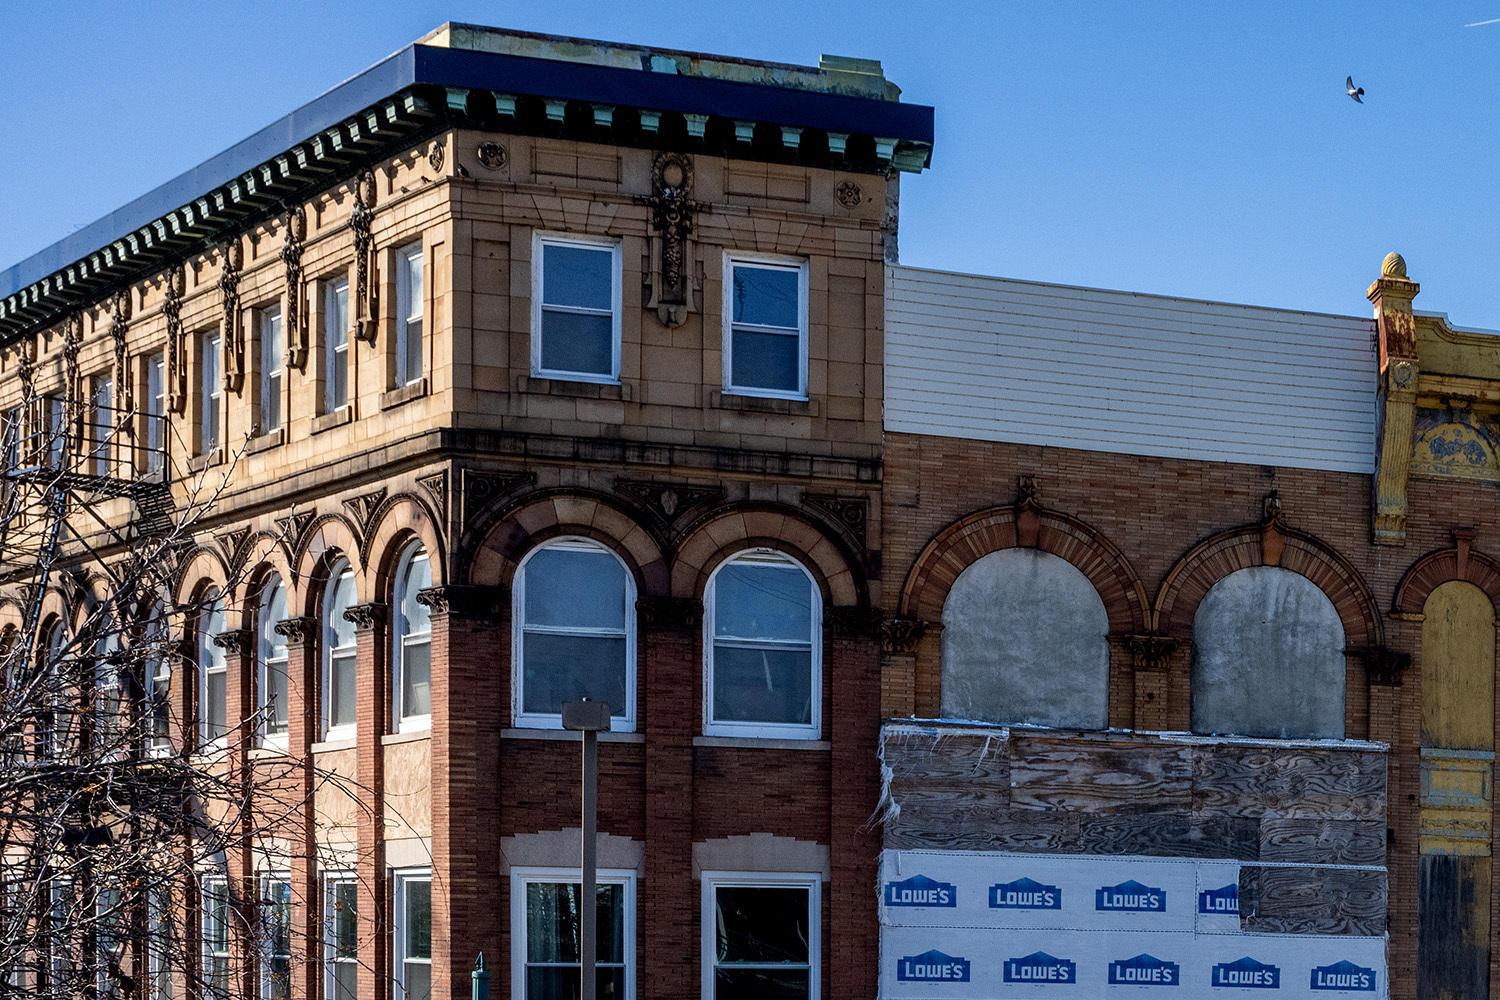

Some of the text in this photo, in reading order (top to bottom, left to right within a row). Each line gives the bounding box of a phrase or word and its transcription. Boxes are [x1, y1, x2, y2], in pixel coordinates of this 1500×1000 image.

[892, 887, 949, 904] LOWE'S
[997, 889, 1054, 906] LOWE'S
[1104, 892, 1159, 908] LOWE'S
[906, 962, 963, 979] LOWE'S
[1012, 964, 1068, 981] LOWE'S
[1117, 966, 1172, 983] LOWE'S
[1220, 969, 1272, 985] LOWE'S
[1318, 972, 1370, 988] LOWE'S
